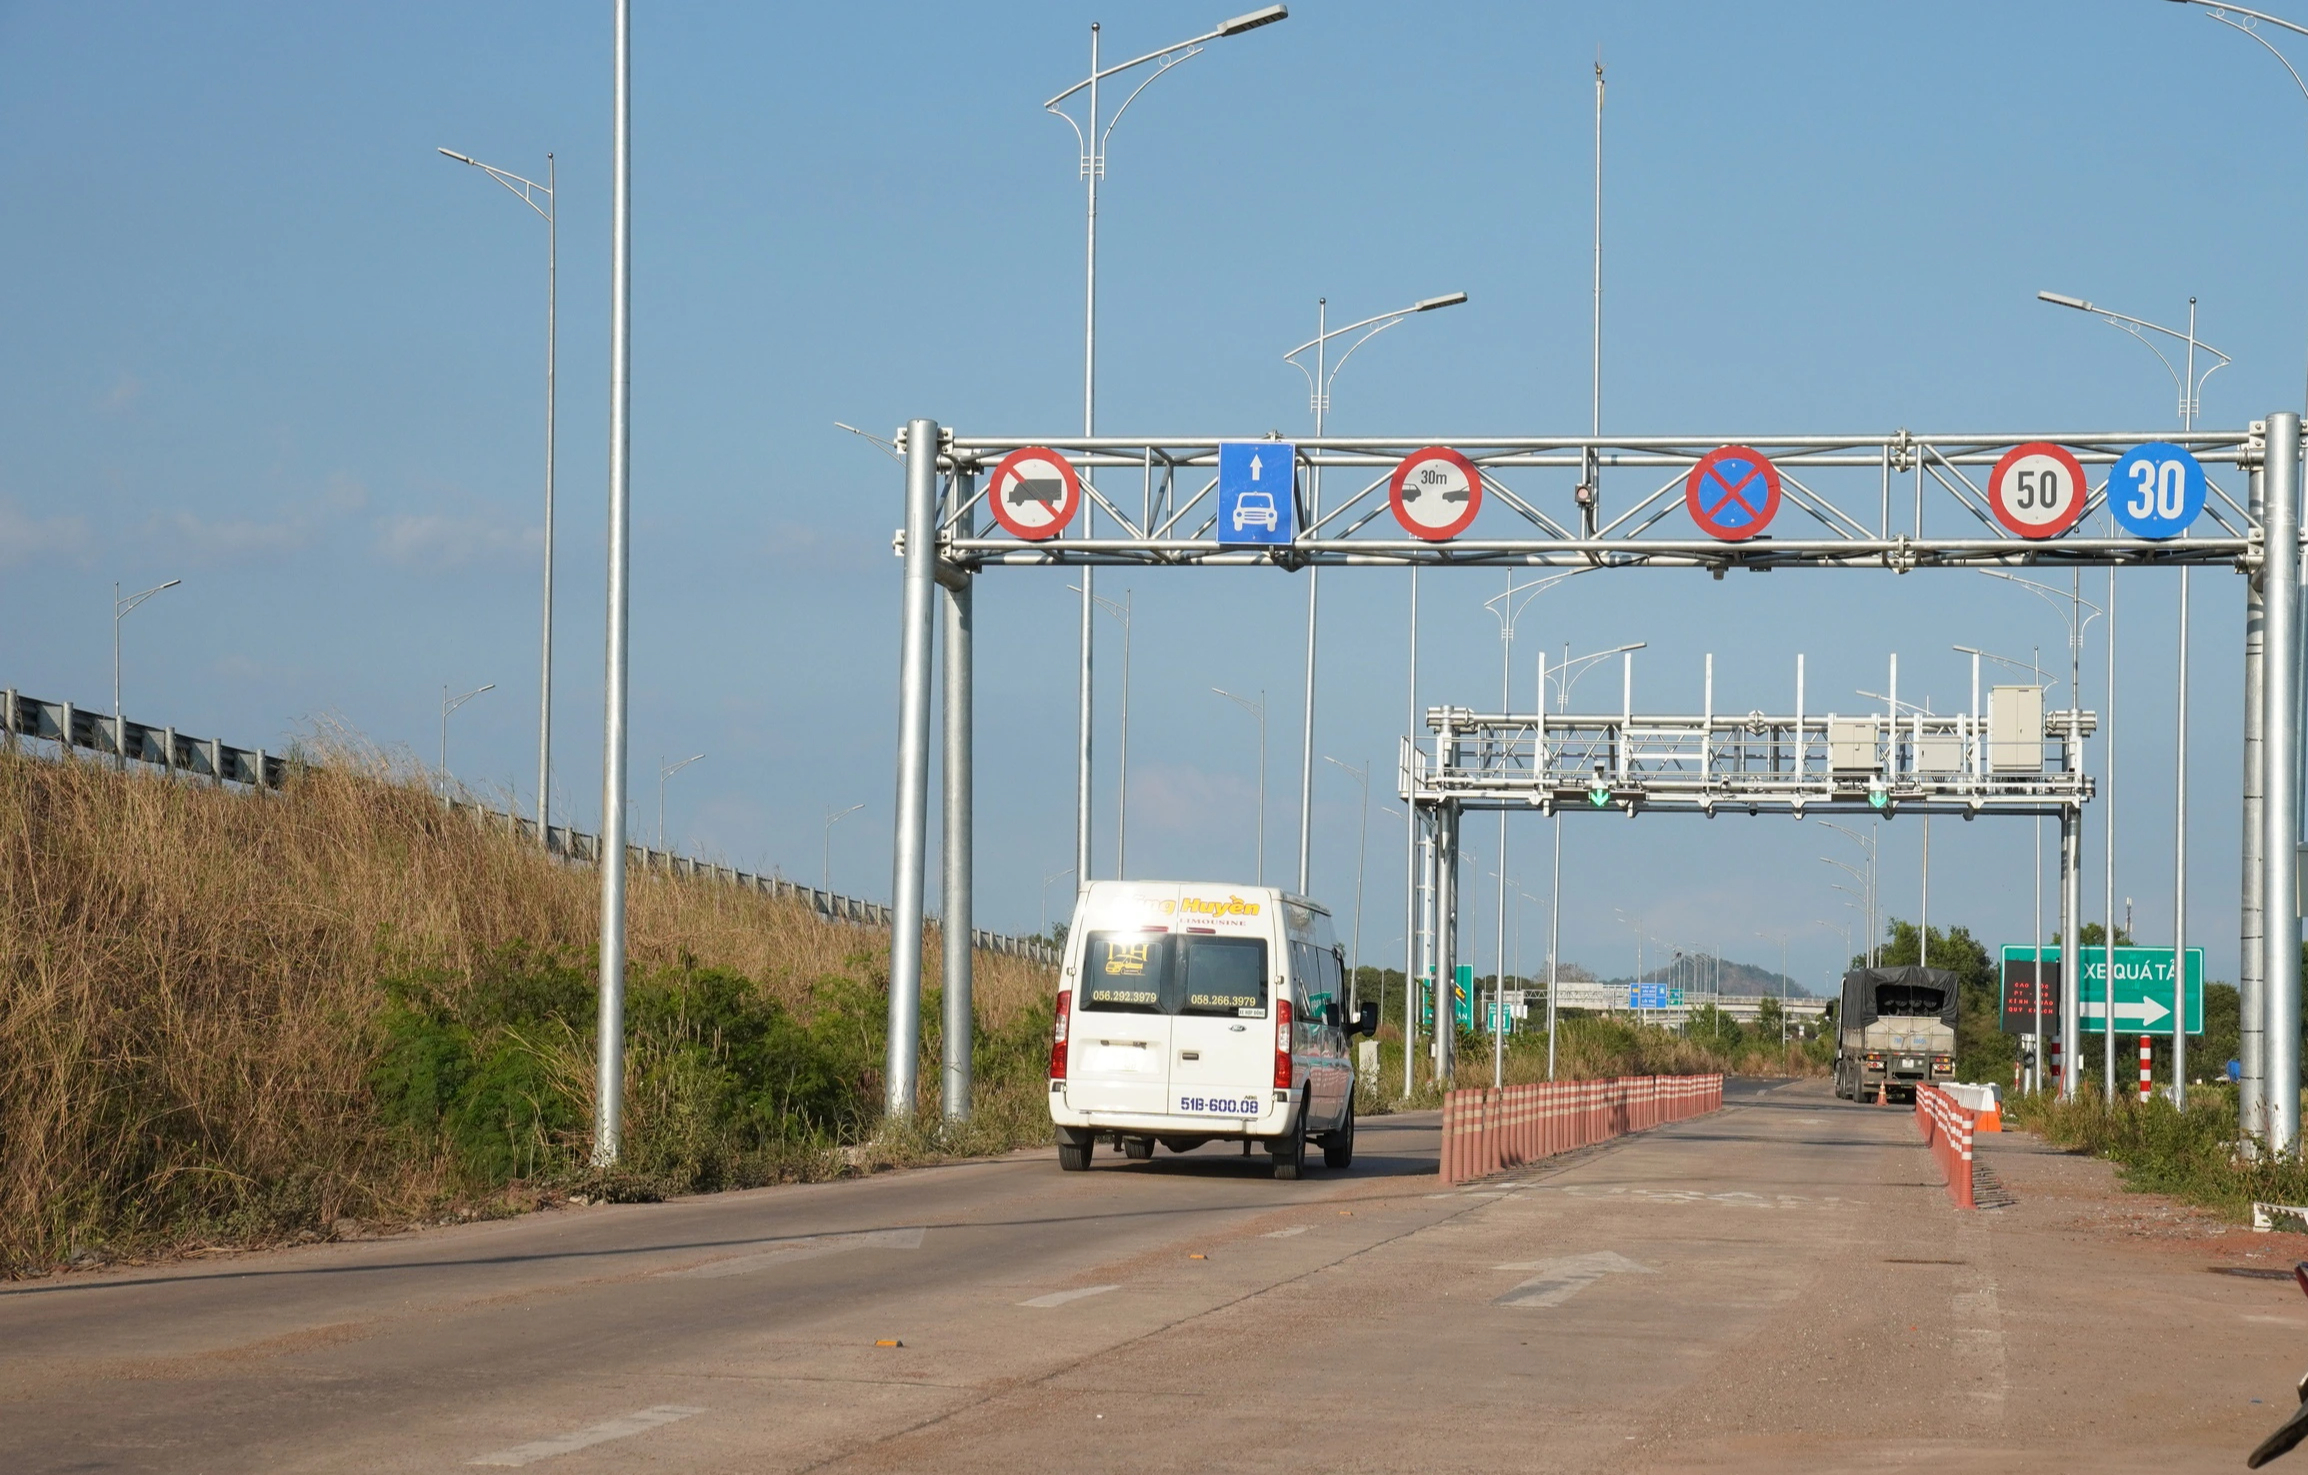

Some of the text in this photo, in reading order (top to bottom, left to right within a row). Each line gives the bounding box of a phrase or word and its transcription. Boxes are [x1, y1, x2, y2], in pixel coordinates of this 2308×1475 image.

[1420, 469, 1448, 485] 30m
[2016, 470, 2058, 509] 50
[2127, 459, 2186, 520] 30
[1180, 894, 1261, 918] Huyền
[1179, 917, 1247, 927] LIMOUSINE
[2083, 963, 2106, 980] XE
[2113, 959, 2153, 980] QUÁ
[1093, 989, 1157, 1003] 056.292.3979
[1190, 994, 1257, 1007] 058.266.3979
[1180, 1096, 1259, 1114] 51B-600.08
